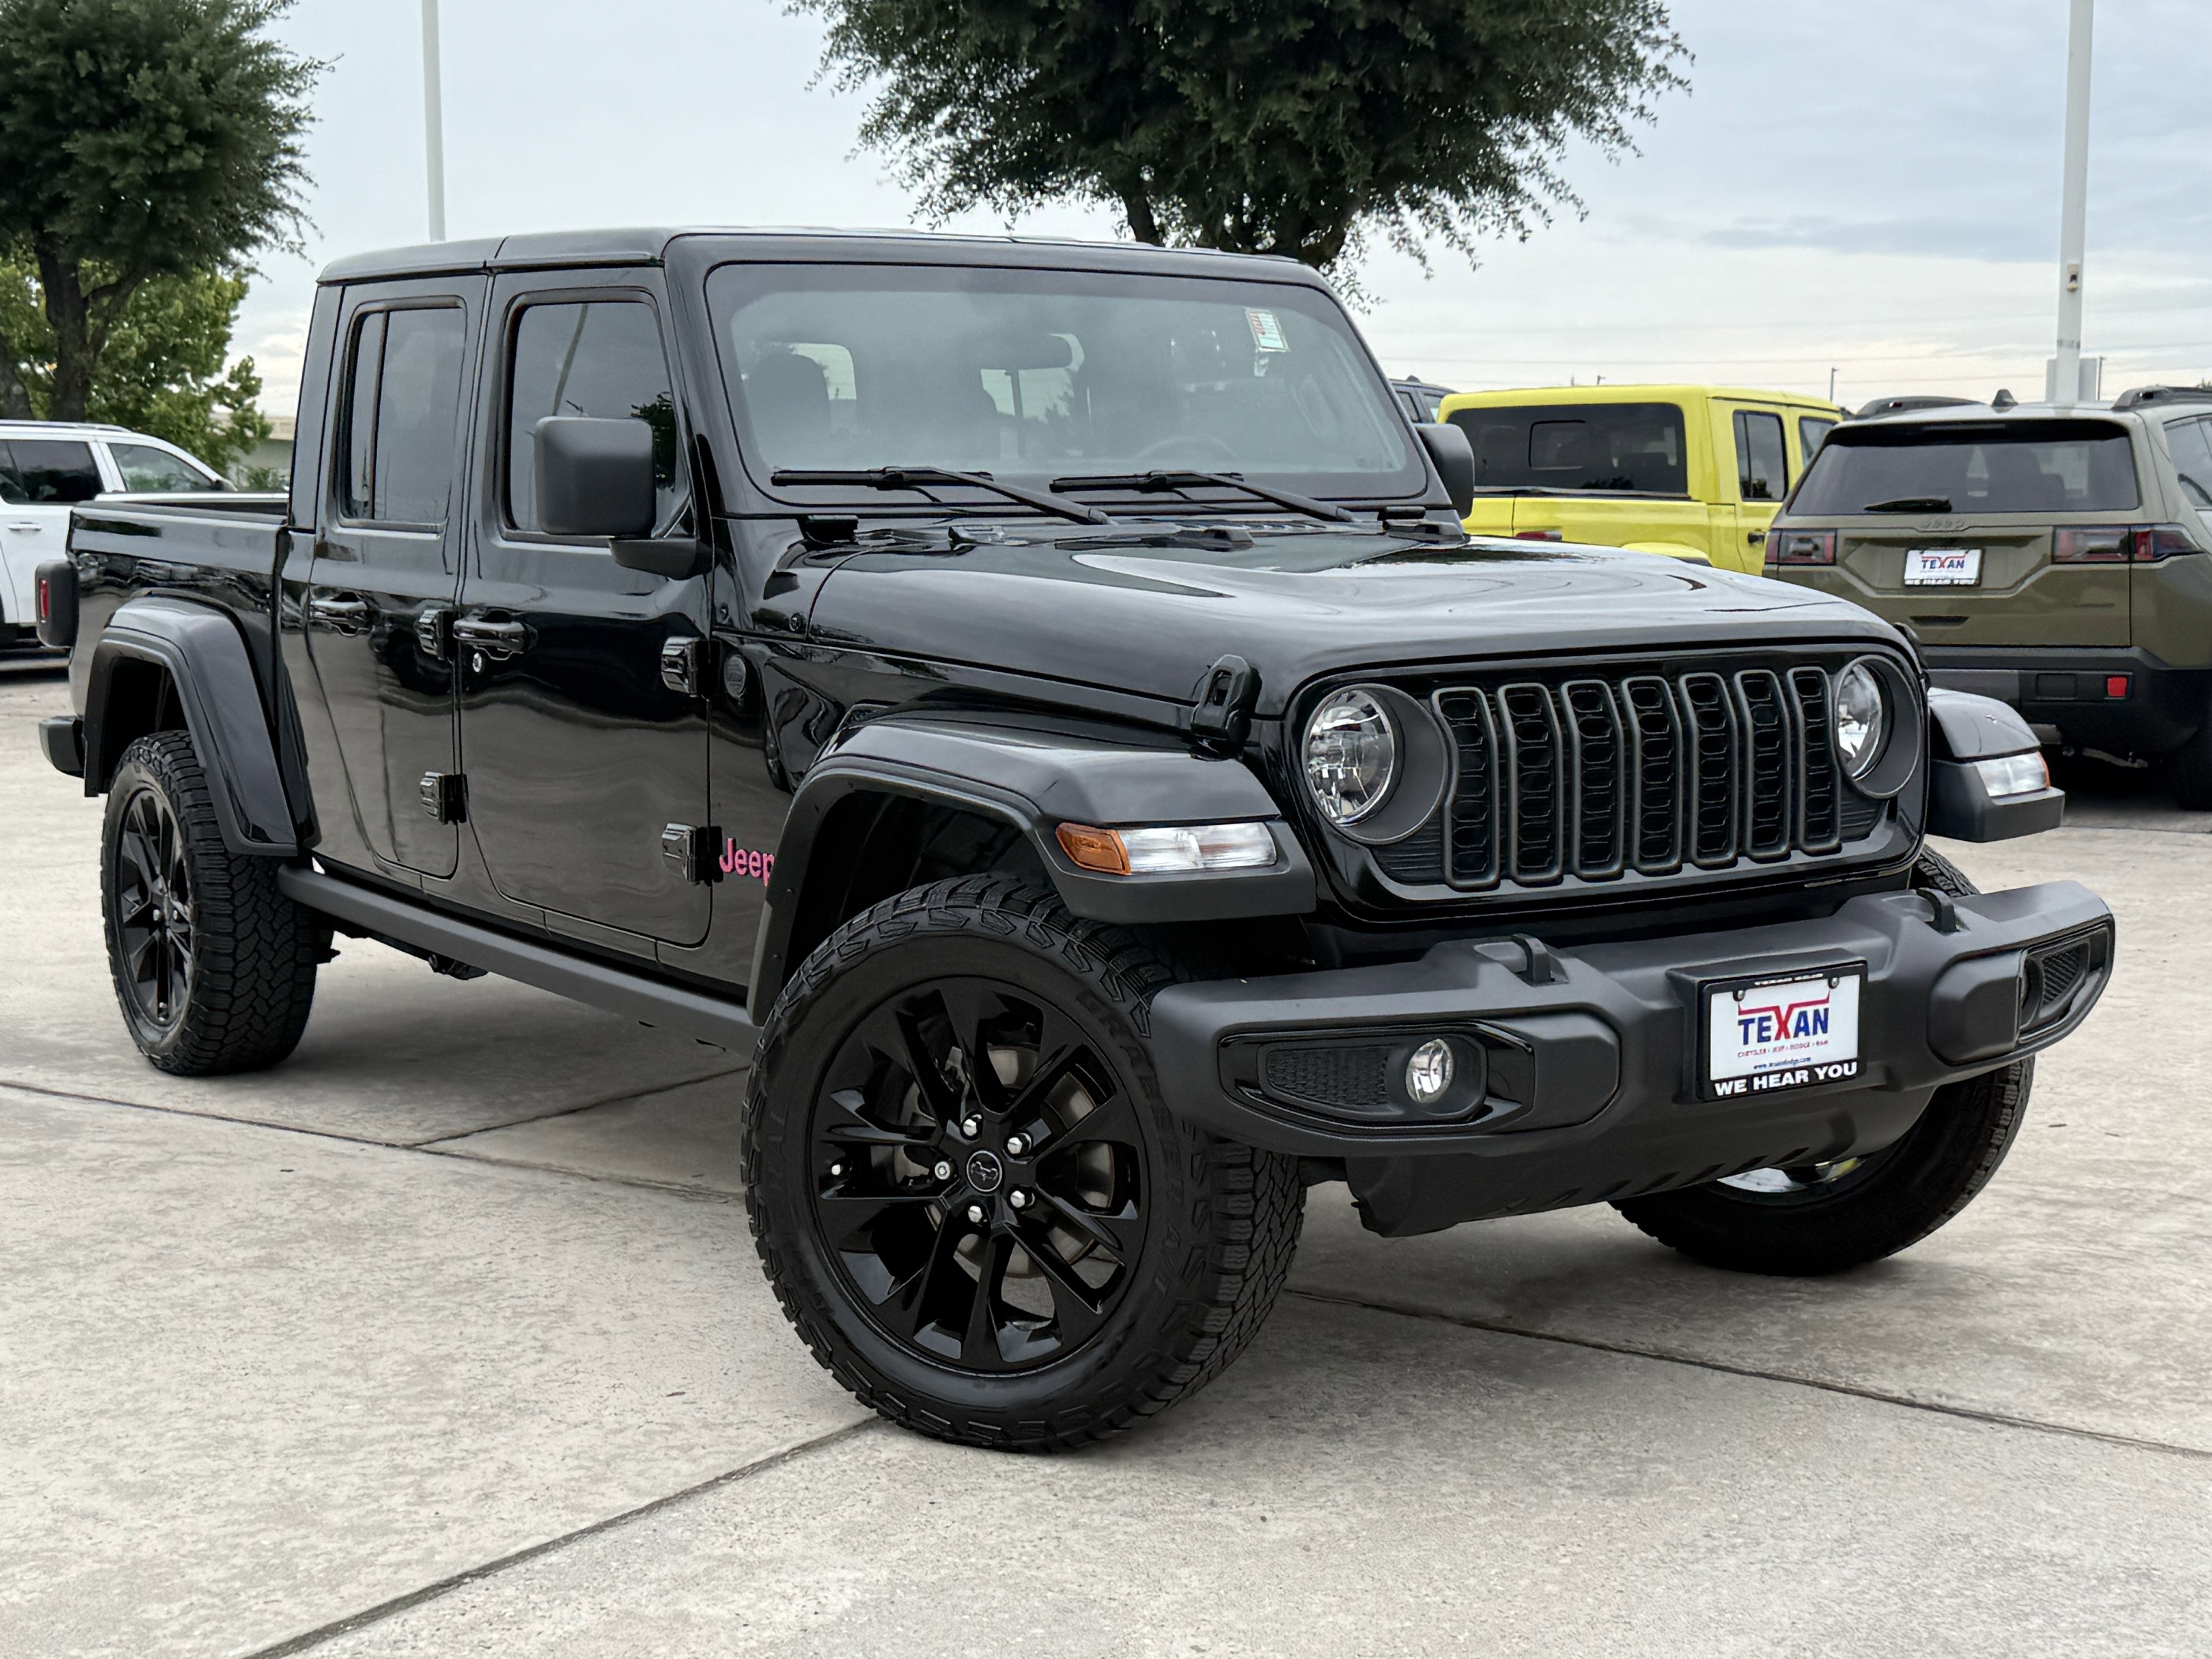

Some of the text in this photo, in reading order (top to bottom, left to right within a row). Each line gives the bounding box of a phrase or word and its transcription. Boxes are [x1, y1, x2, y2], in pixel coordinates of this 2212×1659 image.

[1922, 556, 1965, 569] TEXAN
[719, 838, 775, 887] Jeep
[1738, 1004, 1829, 1046] TEXAN
[1715, 1062, 1857, 1096] WE HEAR YOU
